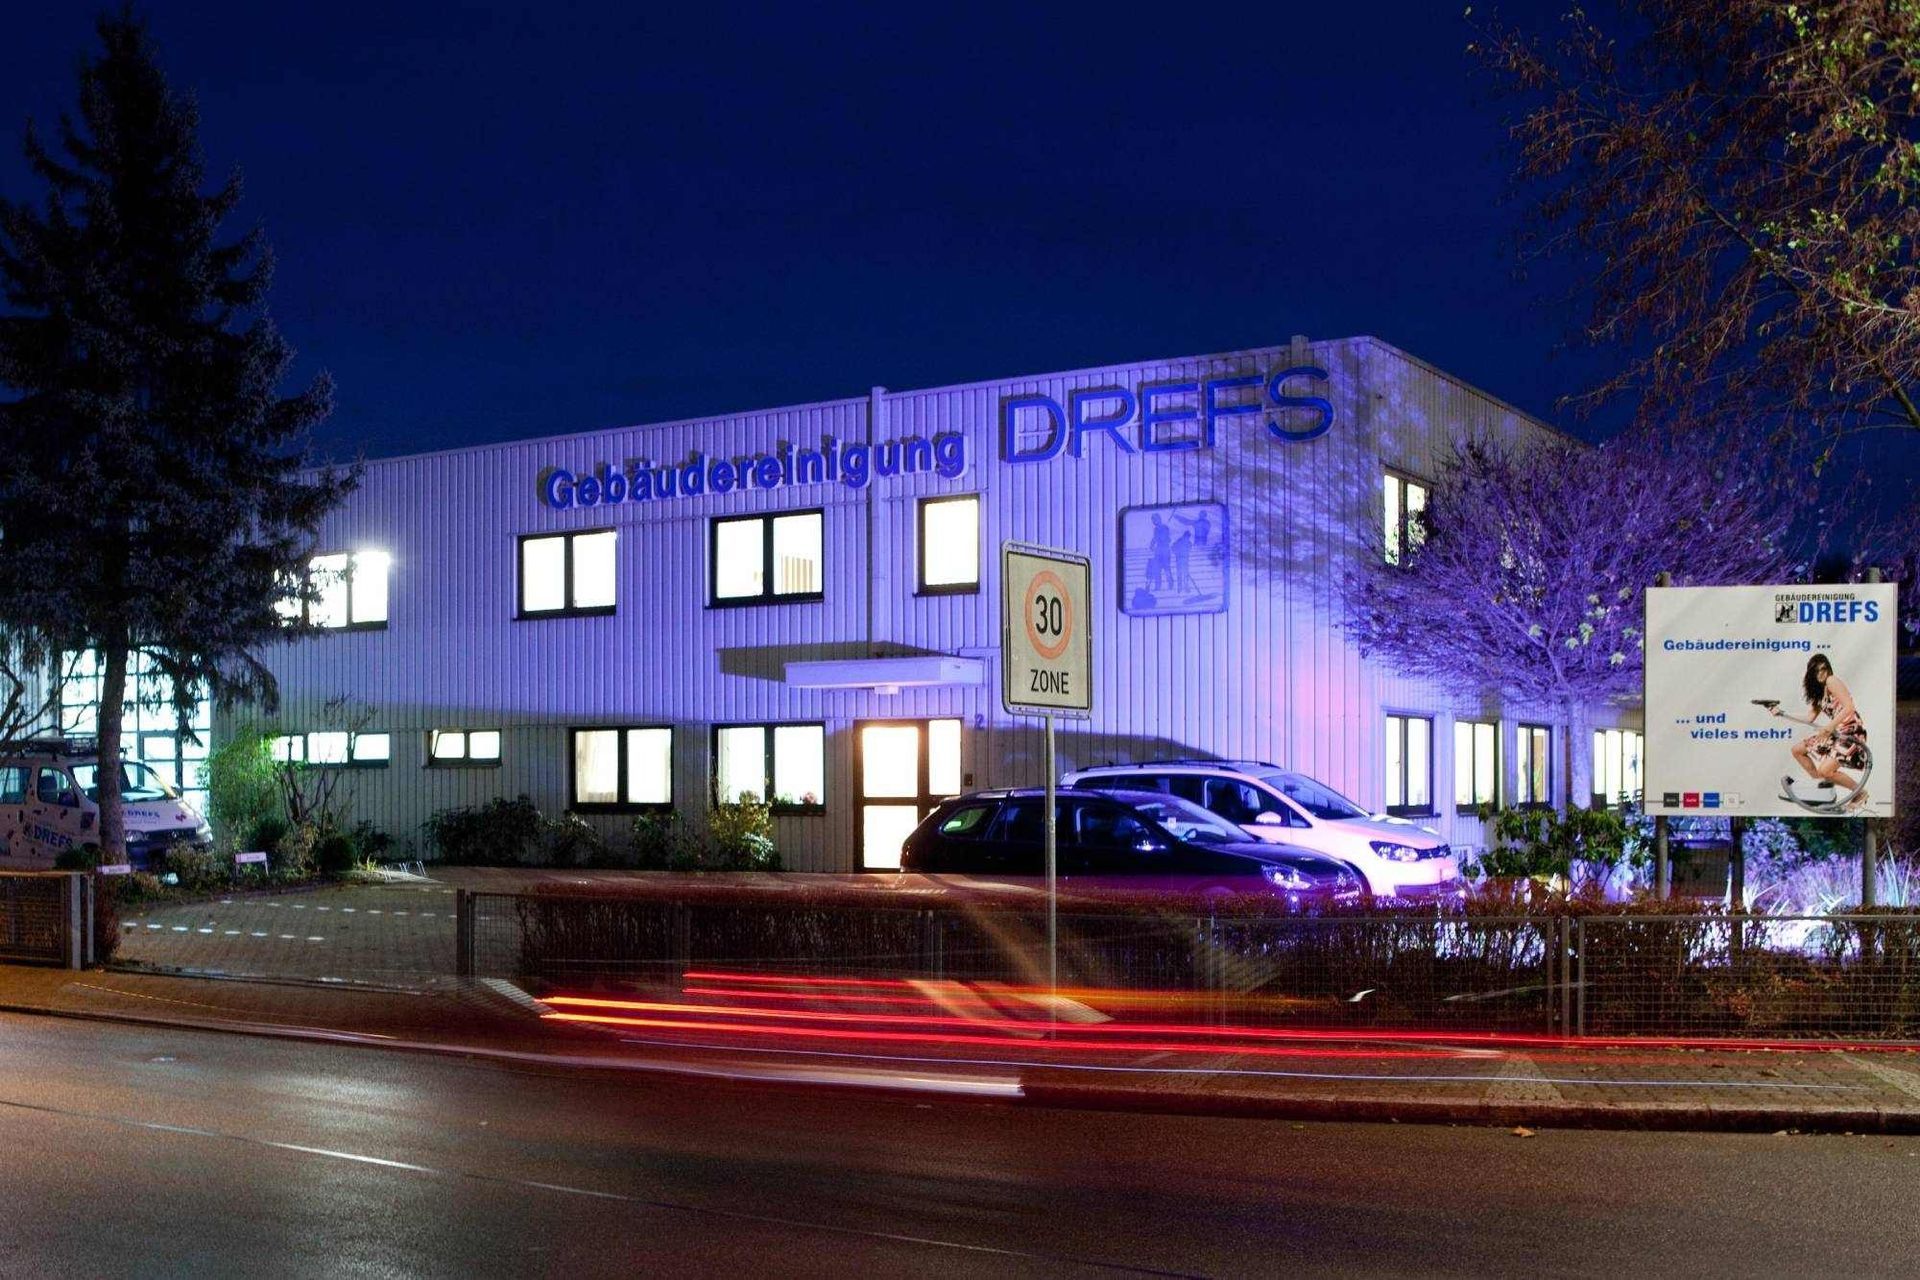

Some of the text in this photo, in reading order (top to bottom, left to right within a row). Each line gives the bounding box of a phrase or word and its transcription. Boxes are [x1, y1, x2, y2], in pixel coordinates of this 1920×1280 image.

[1006, 365, 1334, 463] DREFS
[546, 430, 967, 509] Gebäudereinigung
[1035, 594, 1062, 636] 30
[1800, 601, 1879, 623] DREFS
[1663, 638, 1811, 652] Gebäudereinigung
[1030, 669, 1069, 694] ZONE
[1696, 712, 1726, 724] und
[1691, 727, 1792, 739] vieles mehr!
